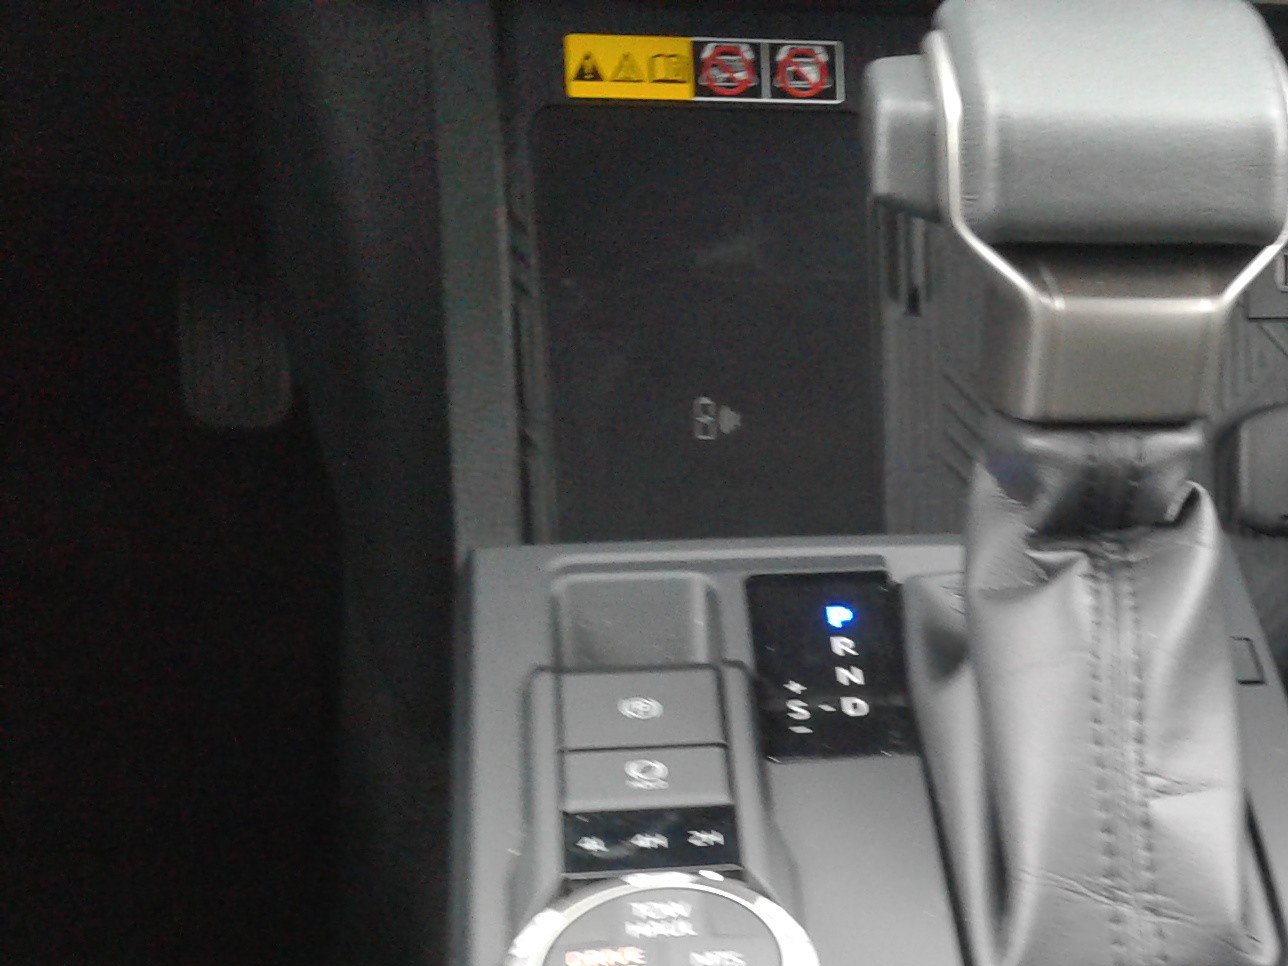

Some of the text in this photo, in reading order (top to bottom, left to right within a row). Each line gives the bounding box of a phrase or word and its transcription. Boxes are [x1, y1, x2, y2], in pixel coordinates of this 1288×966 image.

[825, 605, 855, 628] P
[829, 635, 859, 657] R
[834, 665, 866, 687] N
[786, 699, 811, 720] S
